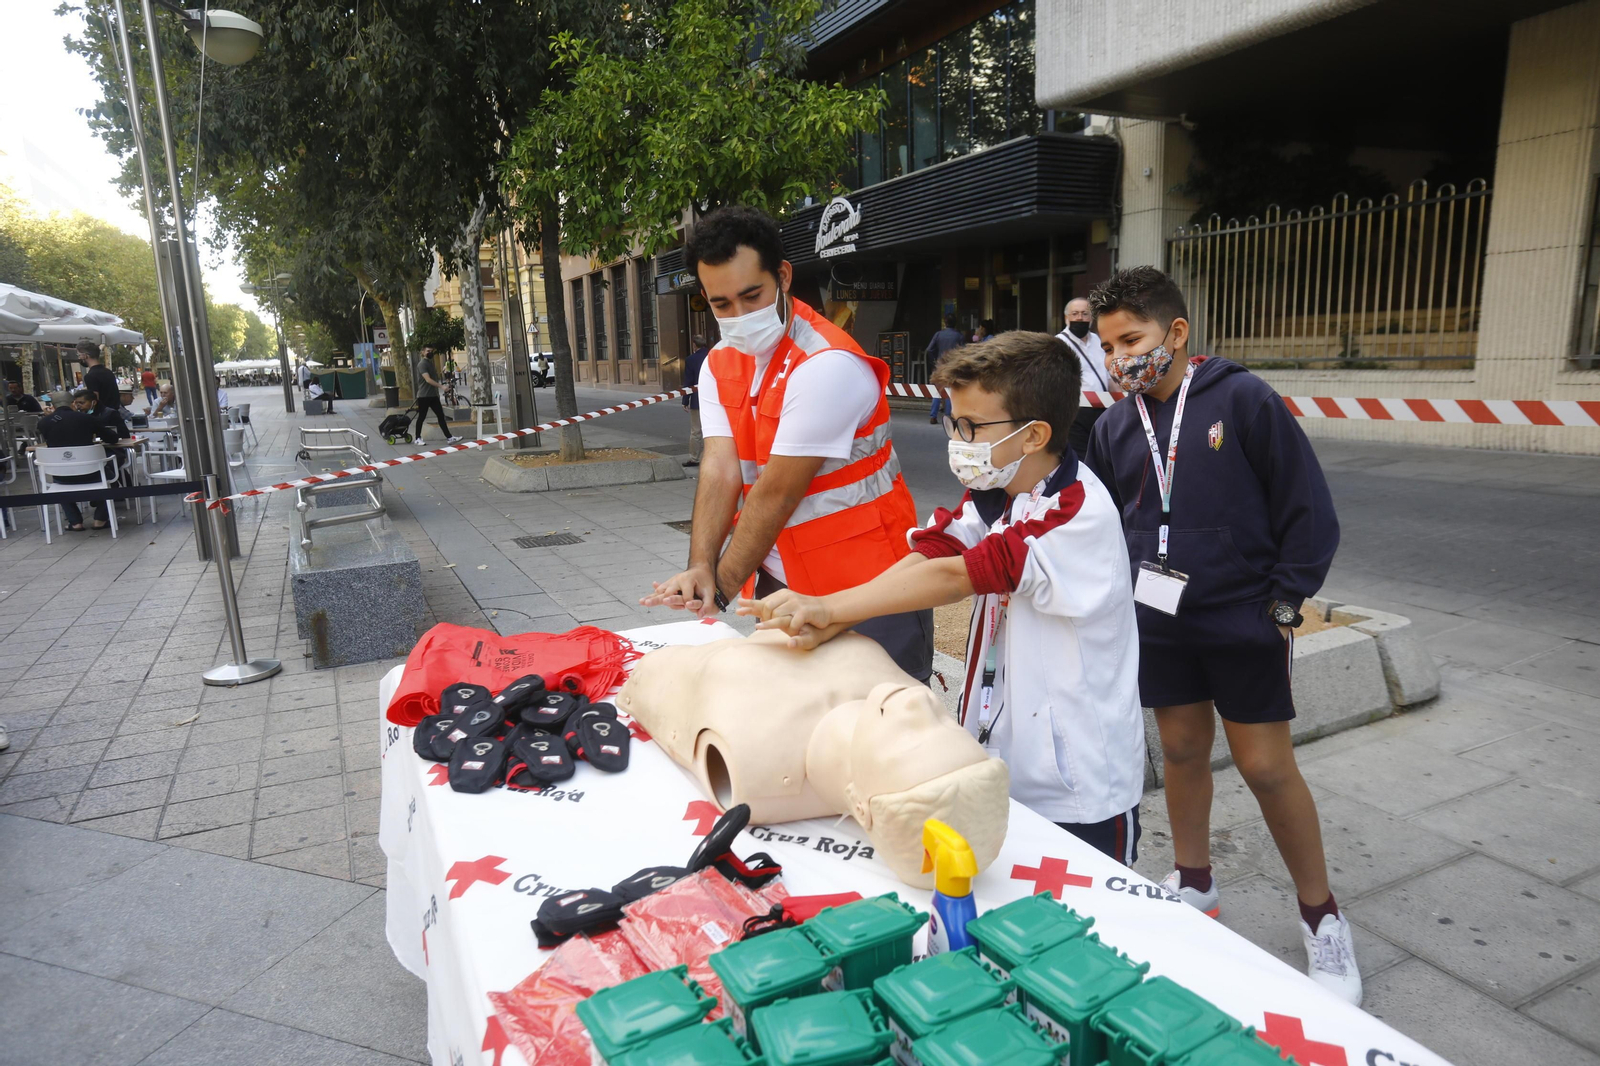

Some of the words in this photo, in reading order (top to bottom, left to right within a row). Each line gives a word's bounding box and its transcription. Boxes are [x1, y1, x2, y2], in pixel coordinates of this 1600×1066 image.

[836, 289, 857, 300] LUNES
[861, 290, 867, 299] A
[638, 640, 670, 650] Roj
[511, 655, 522, 672] VIDA
[749, 826, 810, 847] Cruz
[813, 836, 875, 861] Roja
[513, 873, 571, 898] Cru
